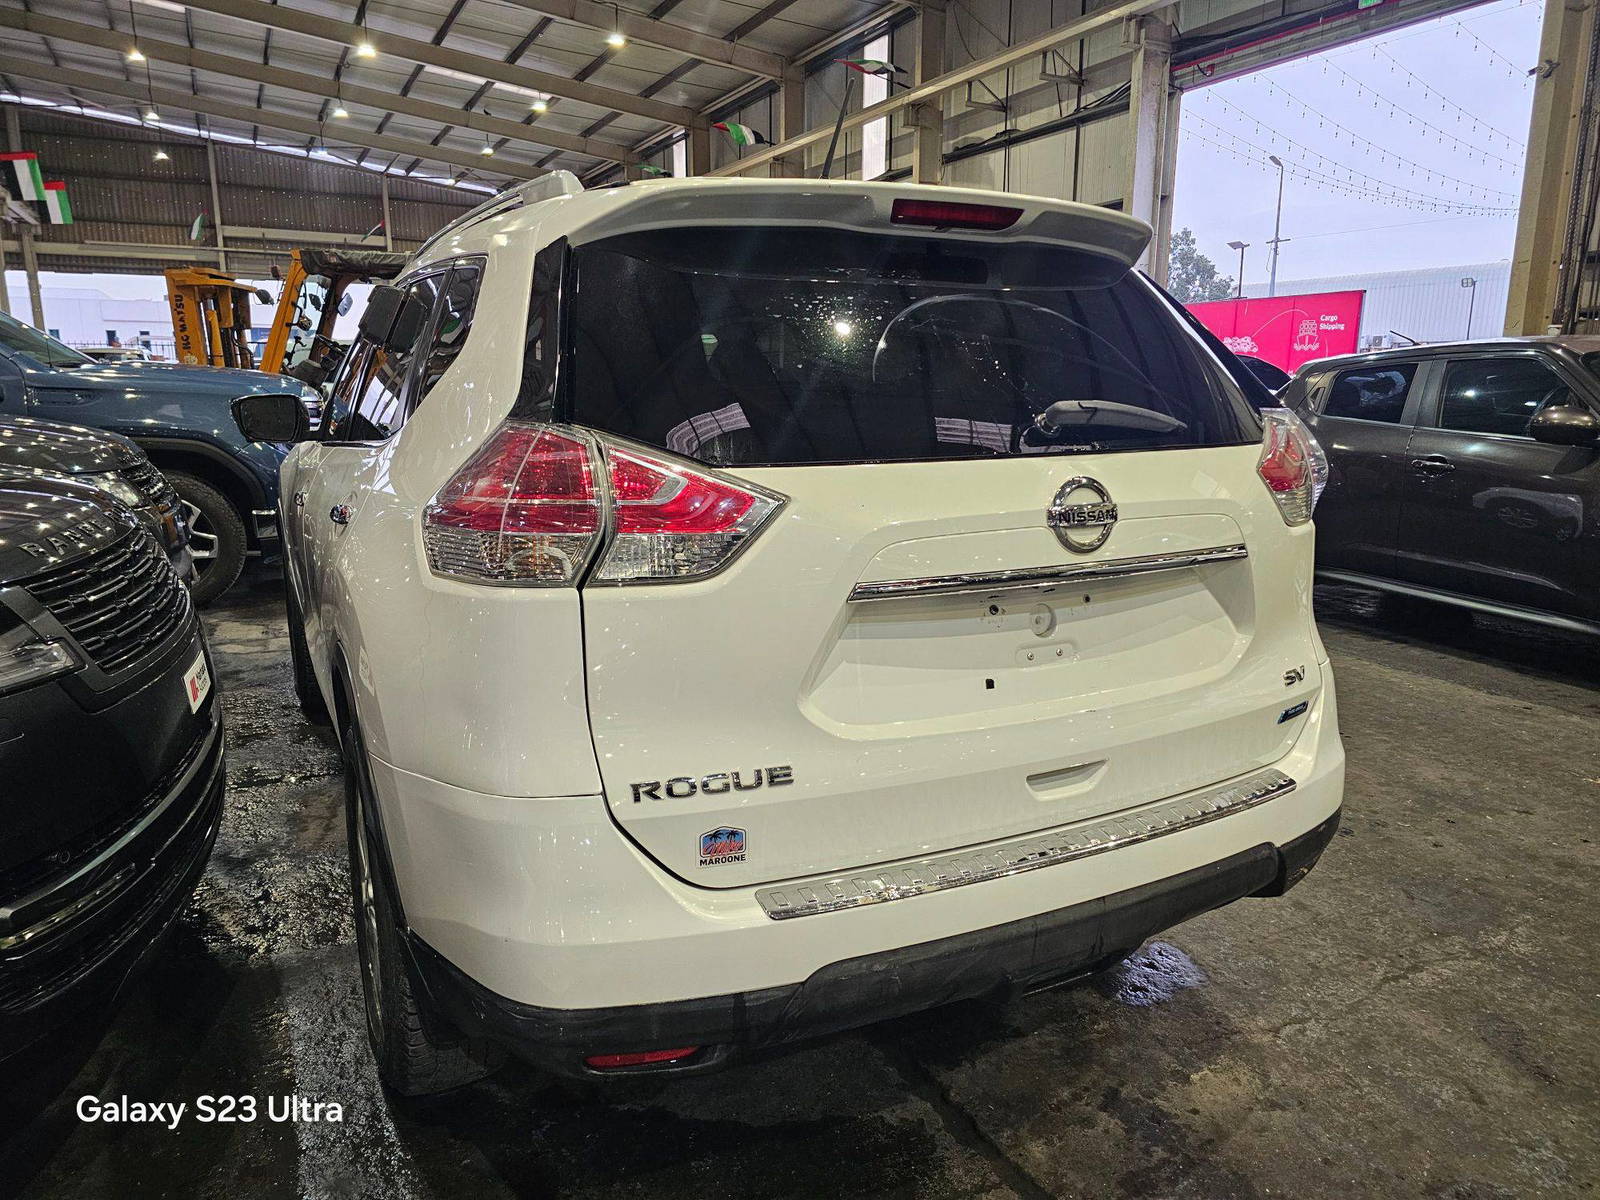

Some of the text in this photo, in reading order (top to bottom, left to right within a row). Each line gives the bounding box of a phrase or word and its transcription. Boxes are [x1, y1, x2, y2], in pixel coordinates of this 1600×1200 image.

[1320, 314, 1338, 322] Cargo
[1319, 323, 1345, 331] Shipping
[1058, 509, 1116, 523] NISSAN
[1283, 665, 1305, 687] SV
[629, 765, 795, 804] ROGUE
[699, 854, 747, 867] MAROONE
